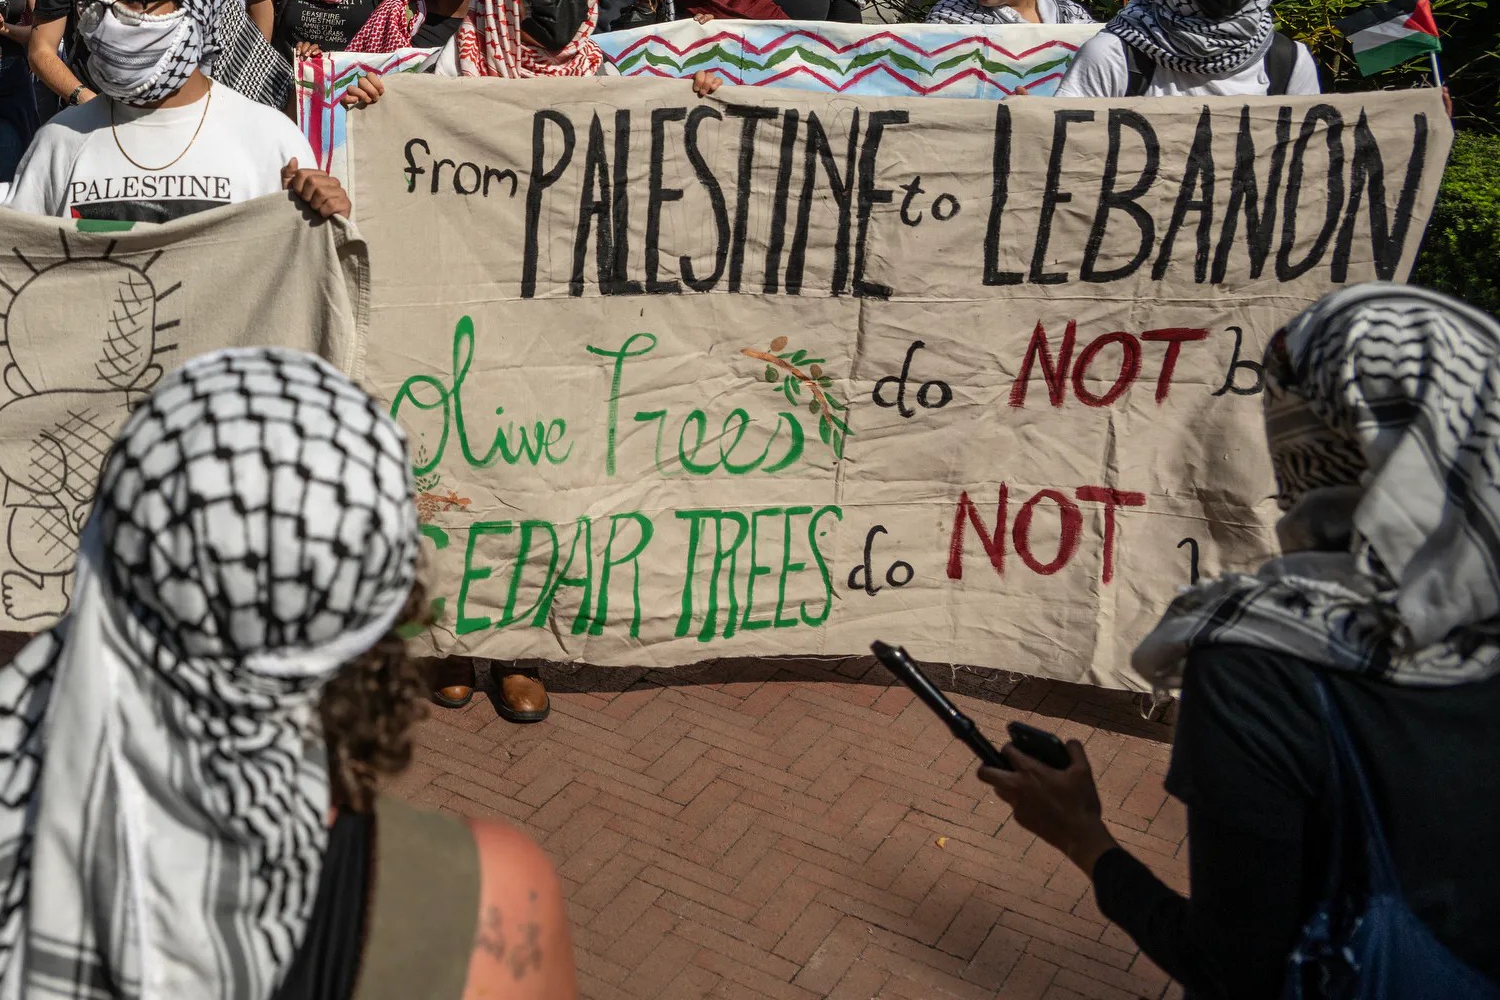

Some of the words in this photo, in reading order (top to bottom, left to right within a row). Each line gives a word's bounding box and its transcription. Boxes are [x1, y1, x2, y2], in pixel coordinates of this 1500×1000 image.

[300, 15, 347, 26] DIVESTMENT
[301, 10, 340, 20] CEASEFIRE
[303, 22, 334, 31] AMNESTY
[70, 175, 232, 204] PALESTINE
[403, 137, 519, 198] from
[520, 104, 910, 301] PALESTINE
[900, 172, 962, 228] to
[982, 103, 1428, 287] LEBANON
[389, 315, 575, 477] Olive
[585, 333, 806, 477] Trees
[873, 339, 953, 418] do
[1009, 319, 1210, 409] NOT
[674, 504, 845, 642] TREES
[846, 524, 916, 596] do
[946, 481, 1146, 586] NOT
